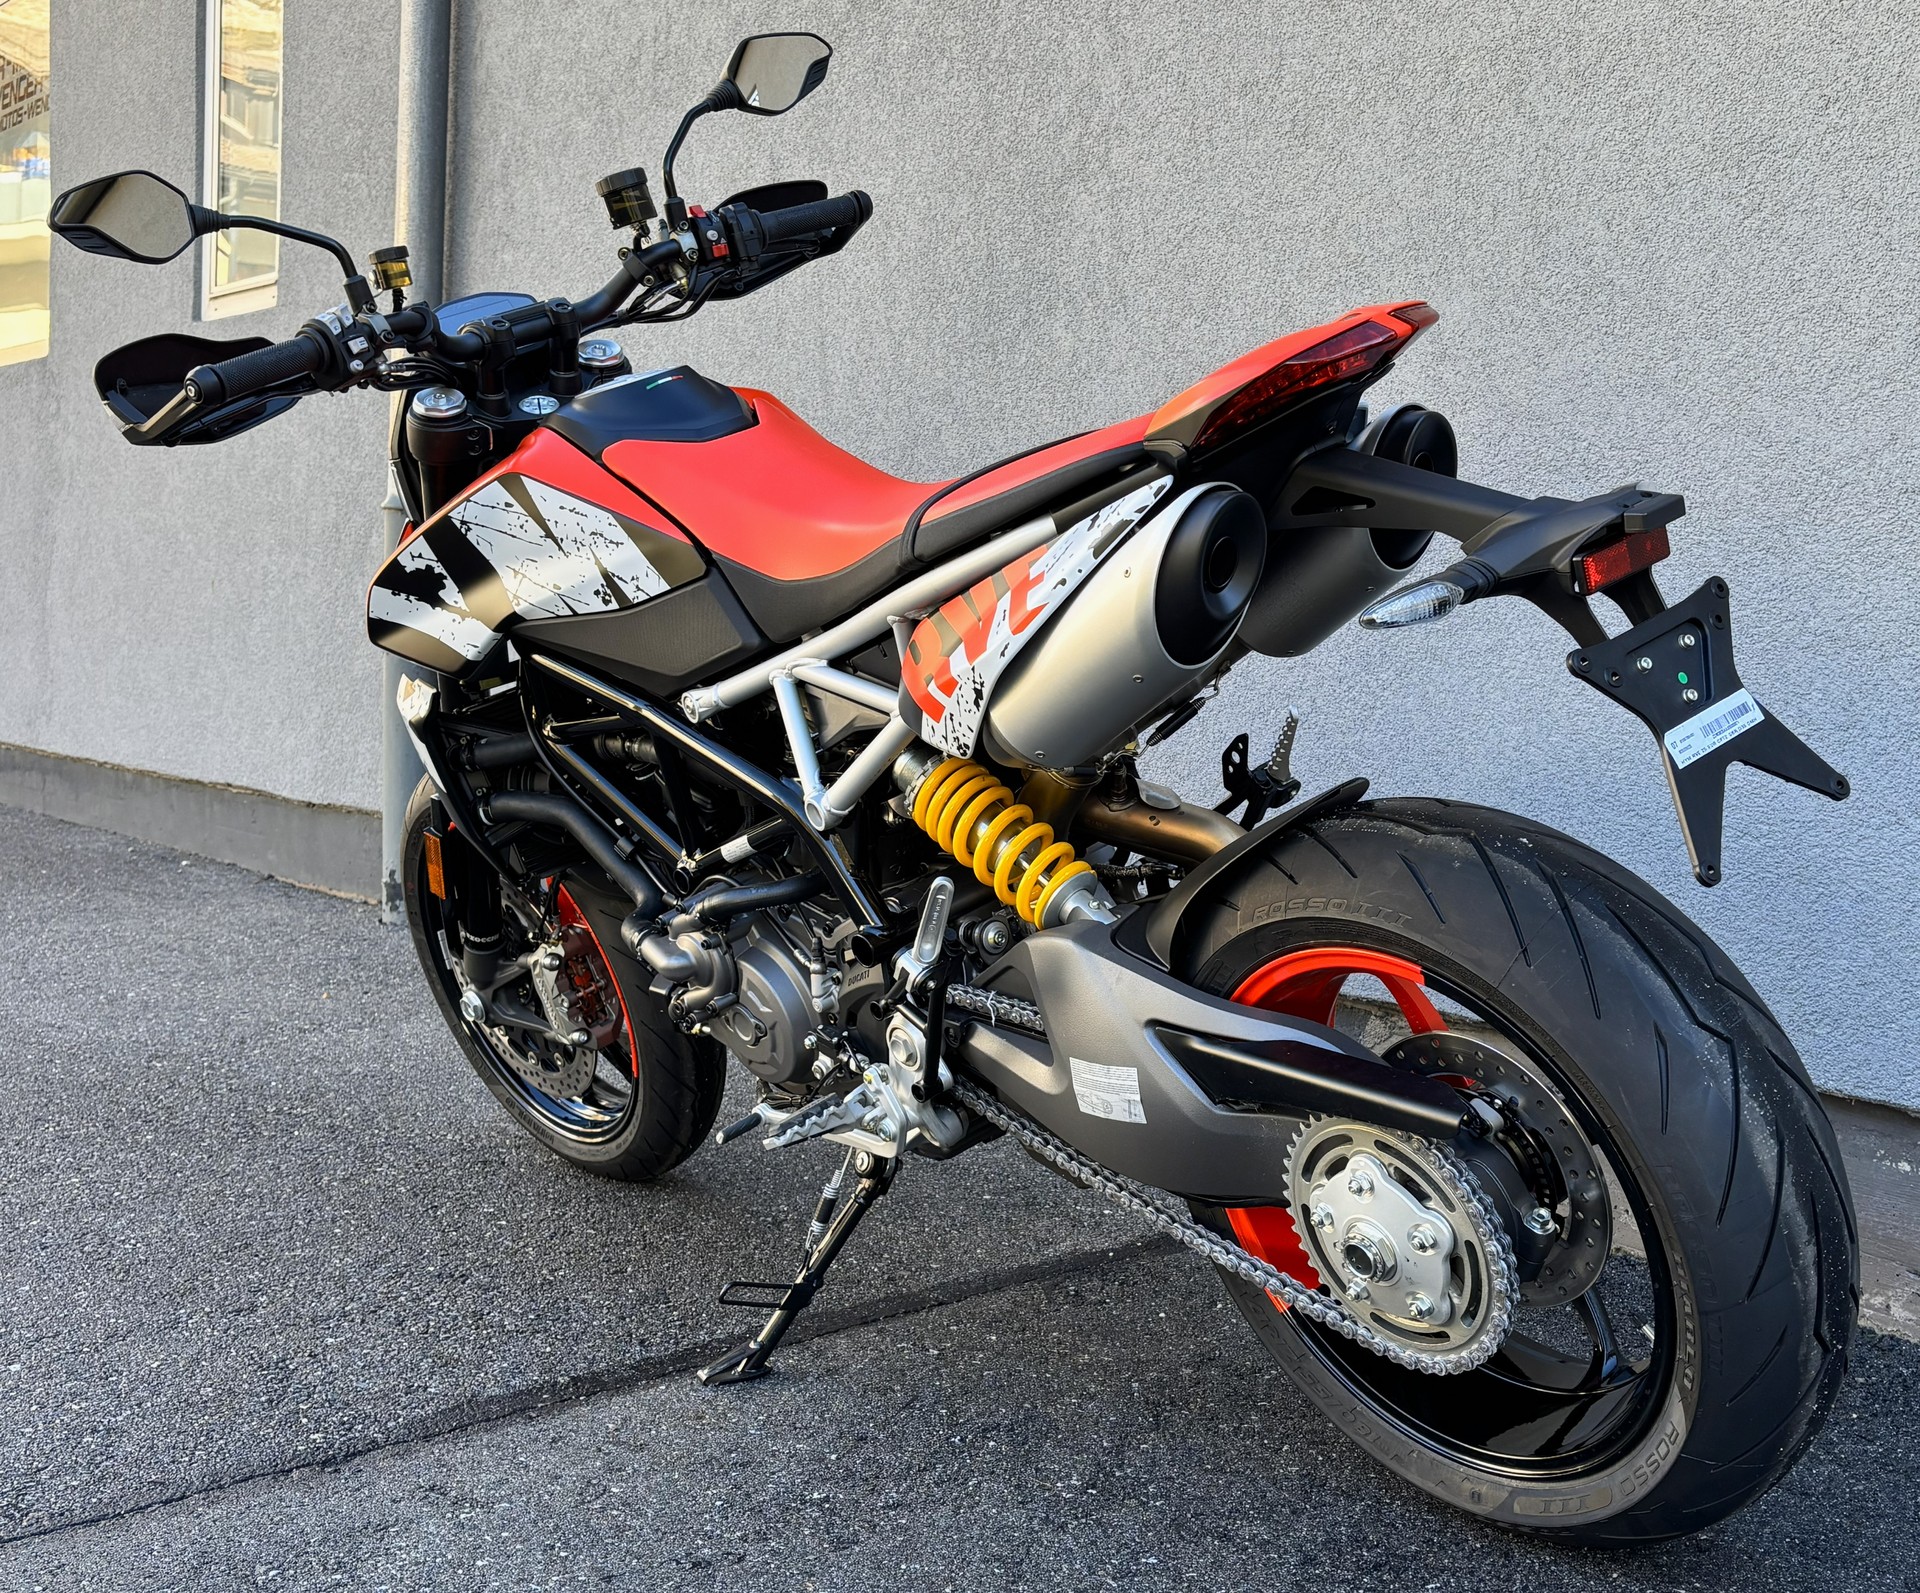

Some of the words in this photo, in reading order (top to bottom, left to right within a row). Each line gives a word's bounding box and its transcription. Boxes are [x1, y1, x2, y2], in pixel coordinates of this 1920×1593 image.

[902, 544, 1050, 724] RVE
[1252, 897, 1348, 924] ROSSO
[1352, 901, 1413, 929] III
[847, 969, 870, 987] DUCATI
[1619, 1420, 1681, 1497] ROSSO
[1538, 1493, 1592, 1515] III
